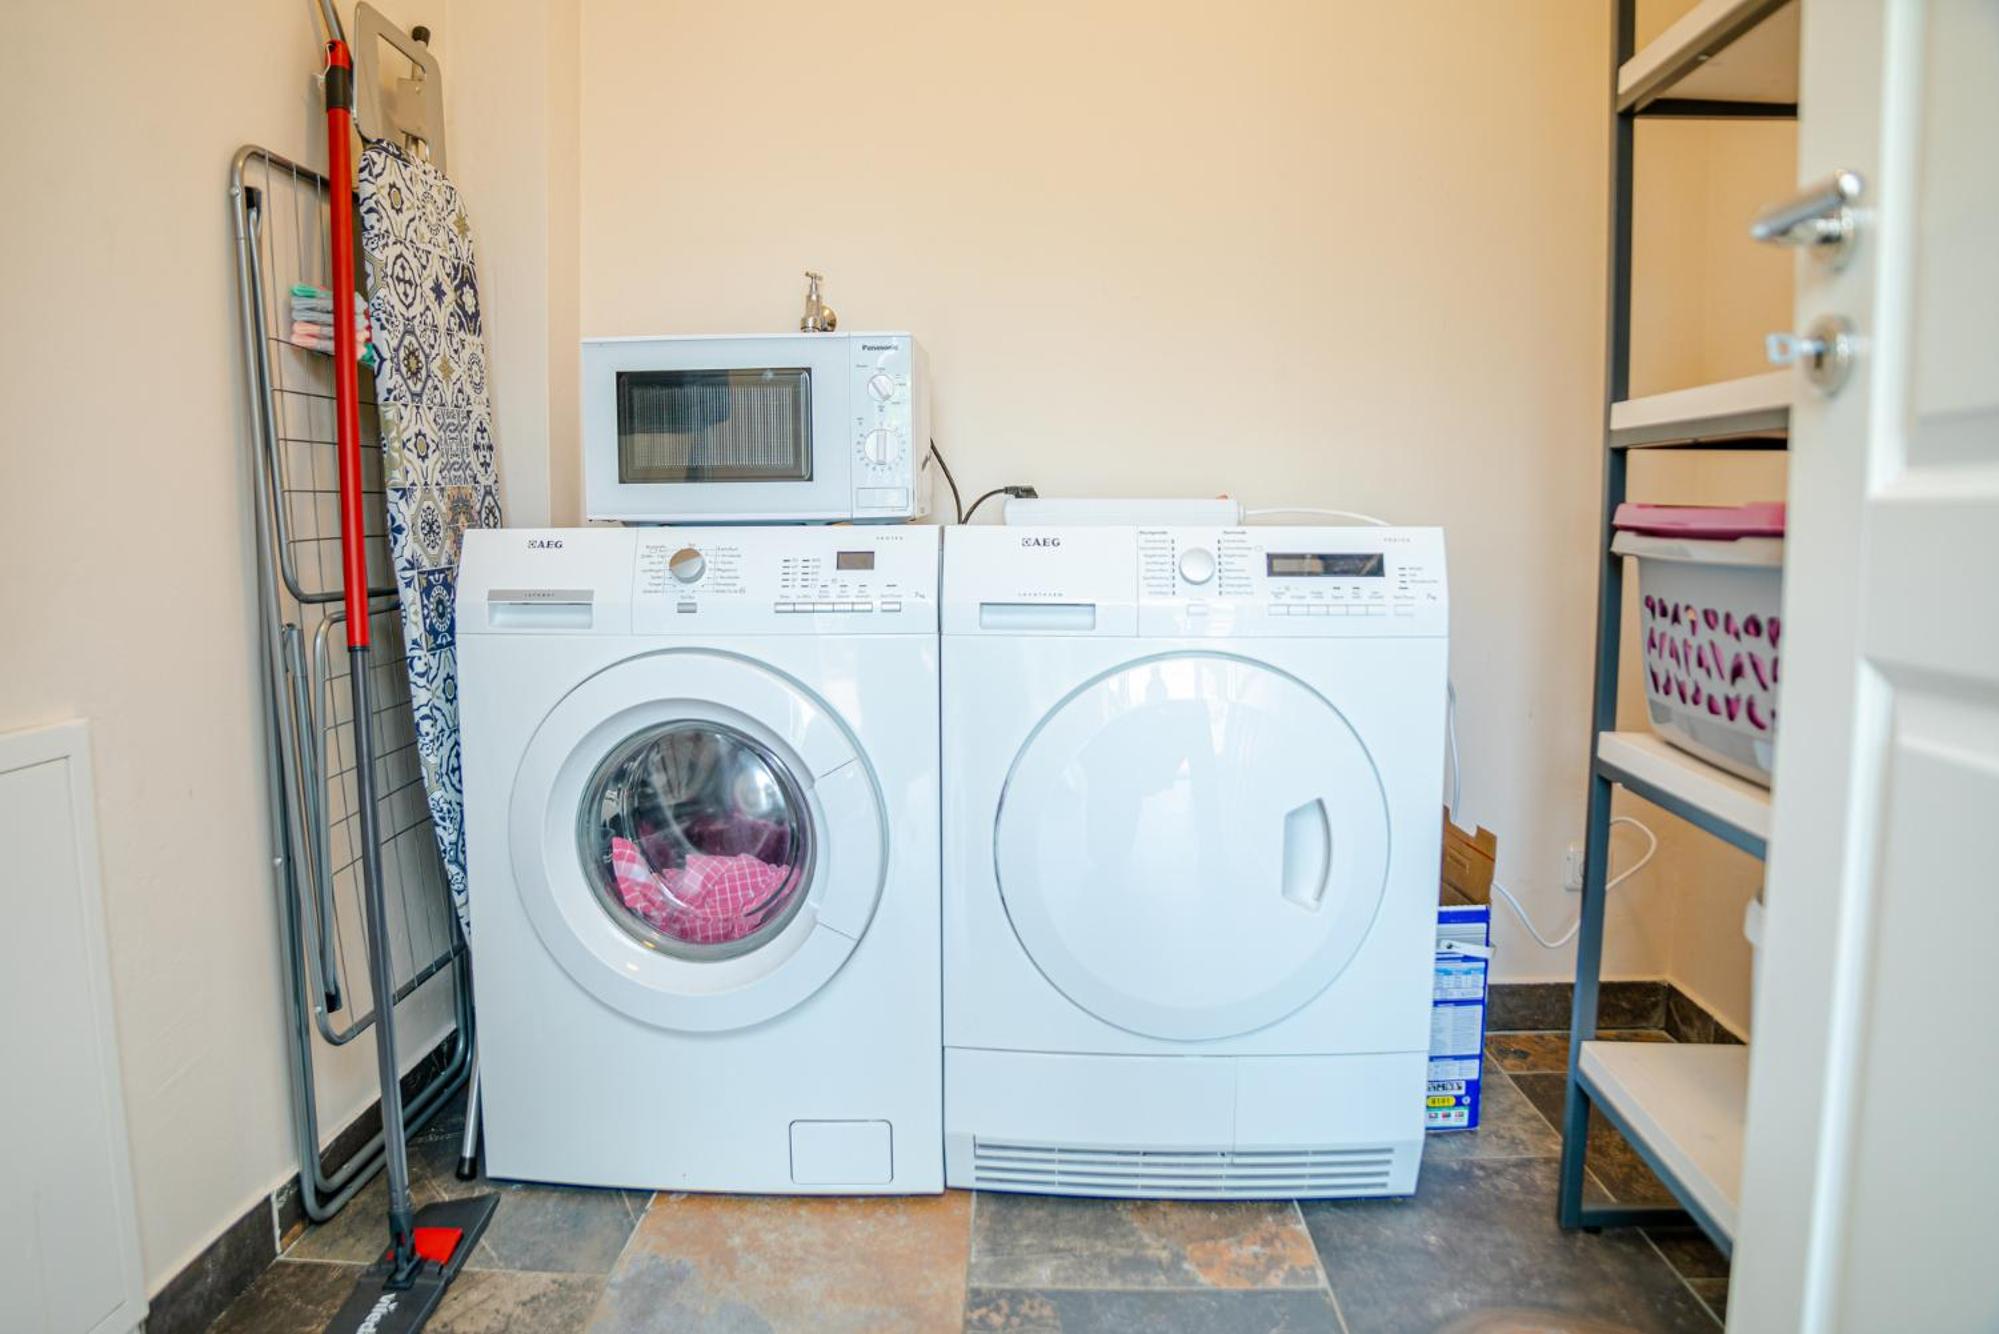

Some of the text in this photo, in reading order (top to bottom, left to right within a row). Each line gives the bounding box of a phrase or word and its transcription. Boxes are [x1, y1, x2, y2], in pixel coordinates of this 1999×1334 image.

[537, 540, 563, 548] AEG
[1032, 538, 1061, 547] AEG
[356, 1293, 398, 1334] viled
